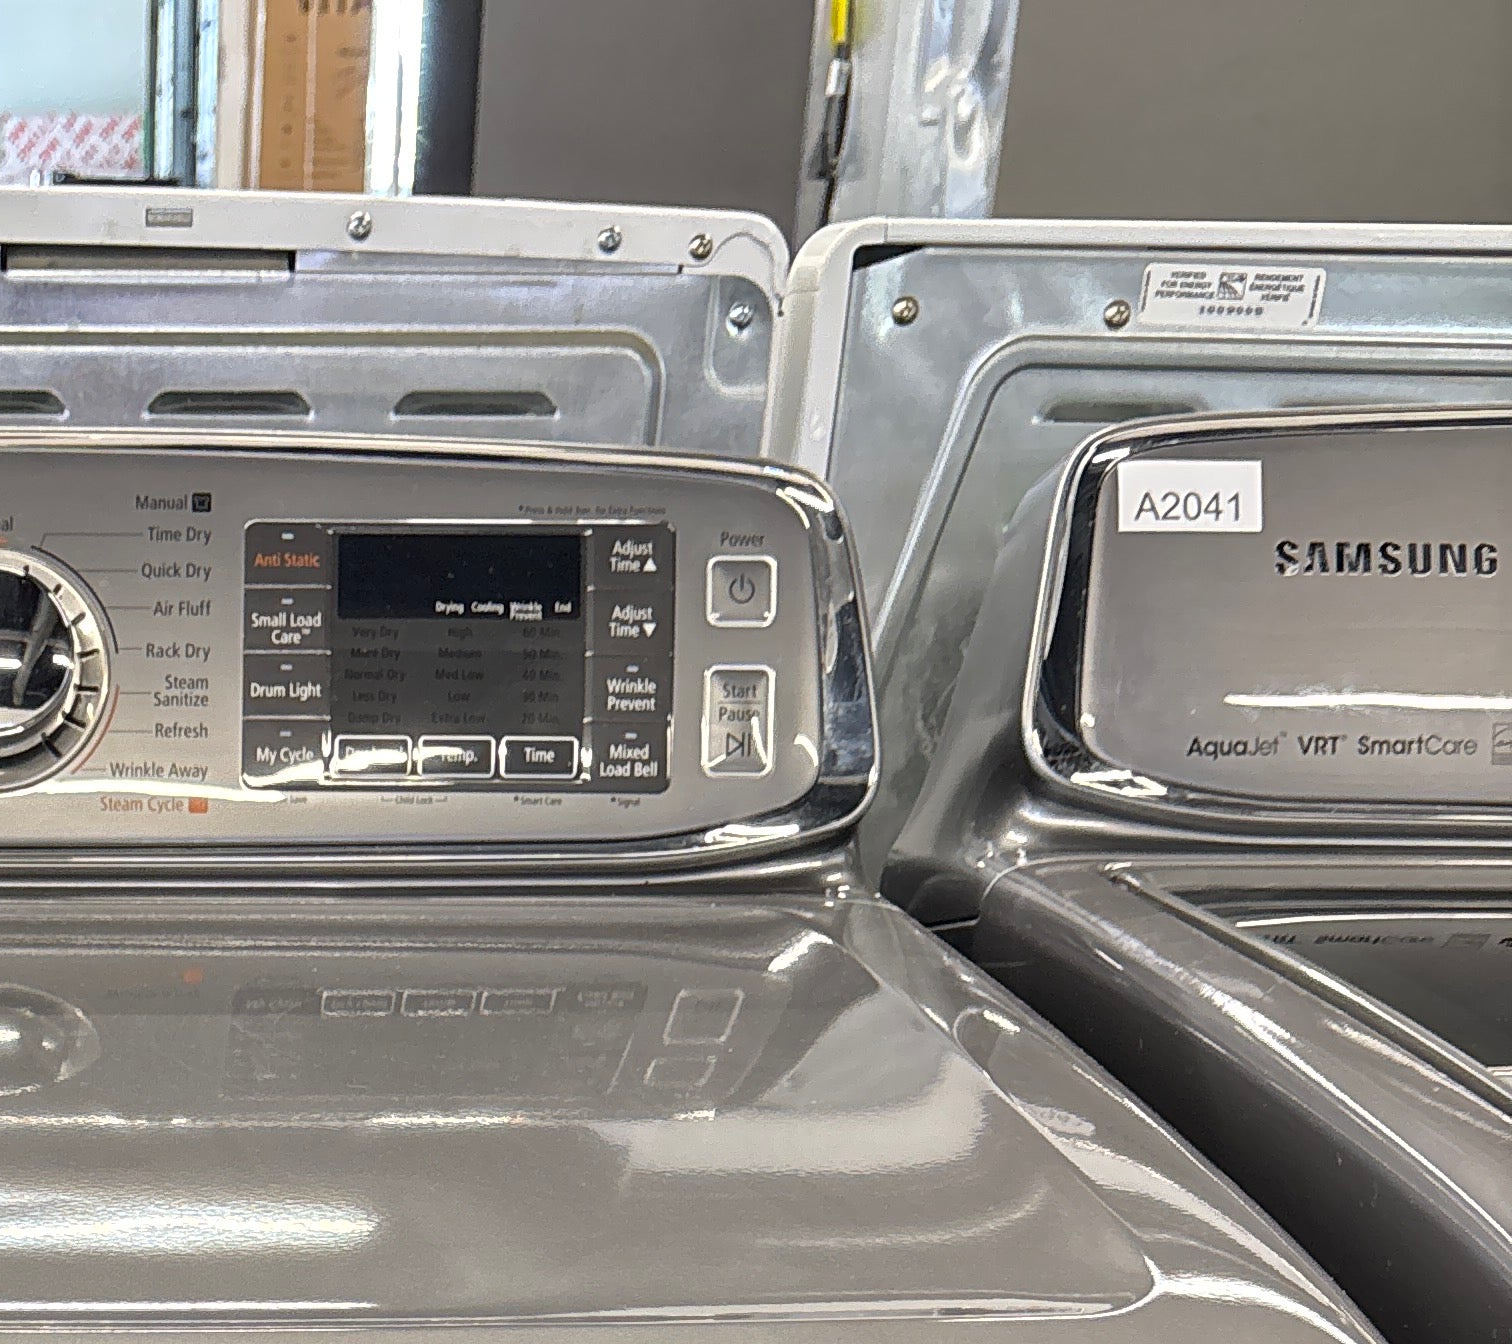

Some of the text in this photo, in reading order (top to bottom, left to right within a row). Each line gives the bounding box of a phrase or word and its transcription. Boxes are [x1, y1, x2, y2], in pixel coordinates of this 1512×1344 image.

[135, 494, 187, 510] Manual
[1133, 492, 1241, 521] A2041
[148, 526, 212, 545] Time Dry
[720, 531, 765, 547] Power
[612, 540, 653, 559] Adjust
[254, 552, 320, 567] Anti Static
[610, 556, 640, 572] Time
[1275, 540, 1499, 576] SAMSUNG
[141, 562, 212, 582] Quick Dry
[153, 601, 211, 616] Air Fluff
[435, 601, 465, 615] Drying
[554, 601, 572, 613] End
[611, 605, 653, 624] Adjust
[251, 612, 322, 627] Small Load
[609, 622, 640, 638] Time
[146, 642, 210, 662] Rack Dry
[165, 674, 209, 690] Steam
[607, 678, 657, 694] Wrinkle
[250, 682, 322, 701] Drum Light
[723, 684, 757, 698] Start
[153, 692, 209, 707] Sanitize
[607, 696, 656, 712] Prevent
[719, 706, 760, 721] Pause
[155, 722, 209, 738] Refresh
[610, 744, 649, 760] Mixed
[1358, 735, 1478, 756] SmartCare
[256, 747, 314, 765] My Cycle
[524, 747, 555, 763] Time
[109, 762, 209, 782] Wrinkle Away
[600, 761, 658, 777] Load Bell
[100, 797, 185, 813] Steam Cycle
